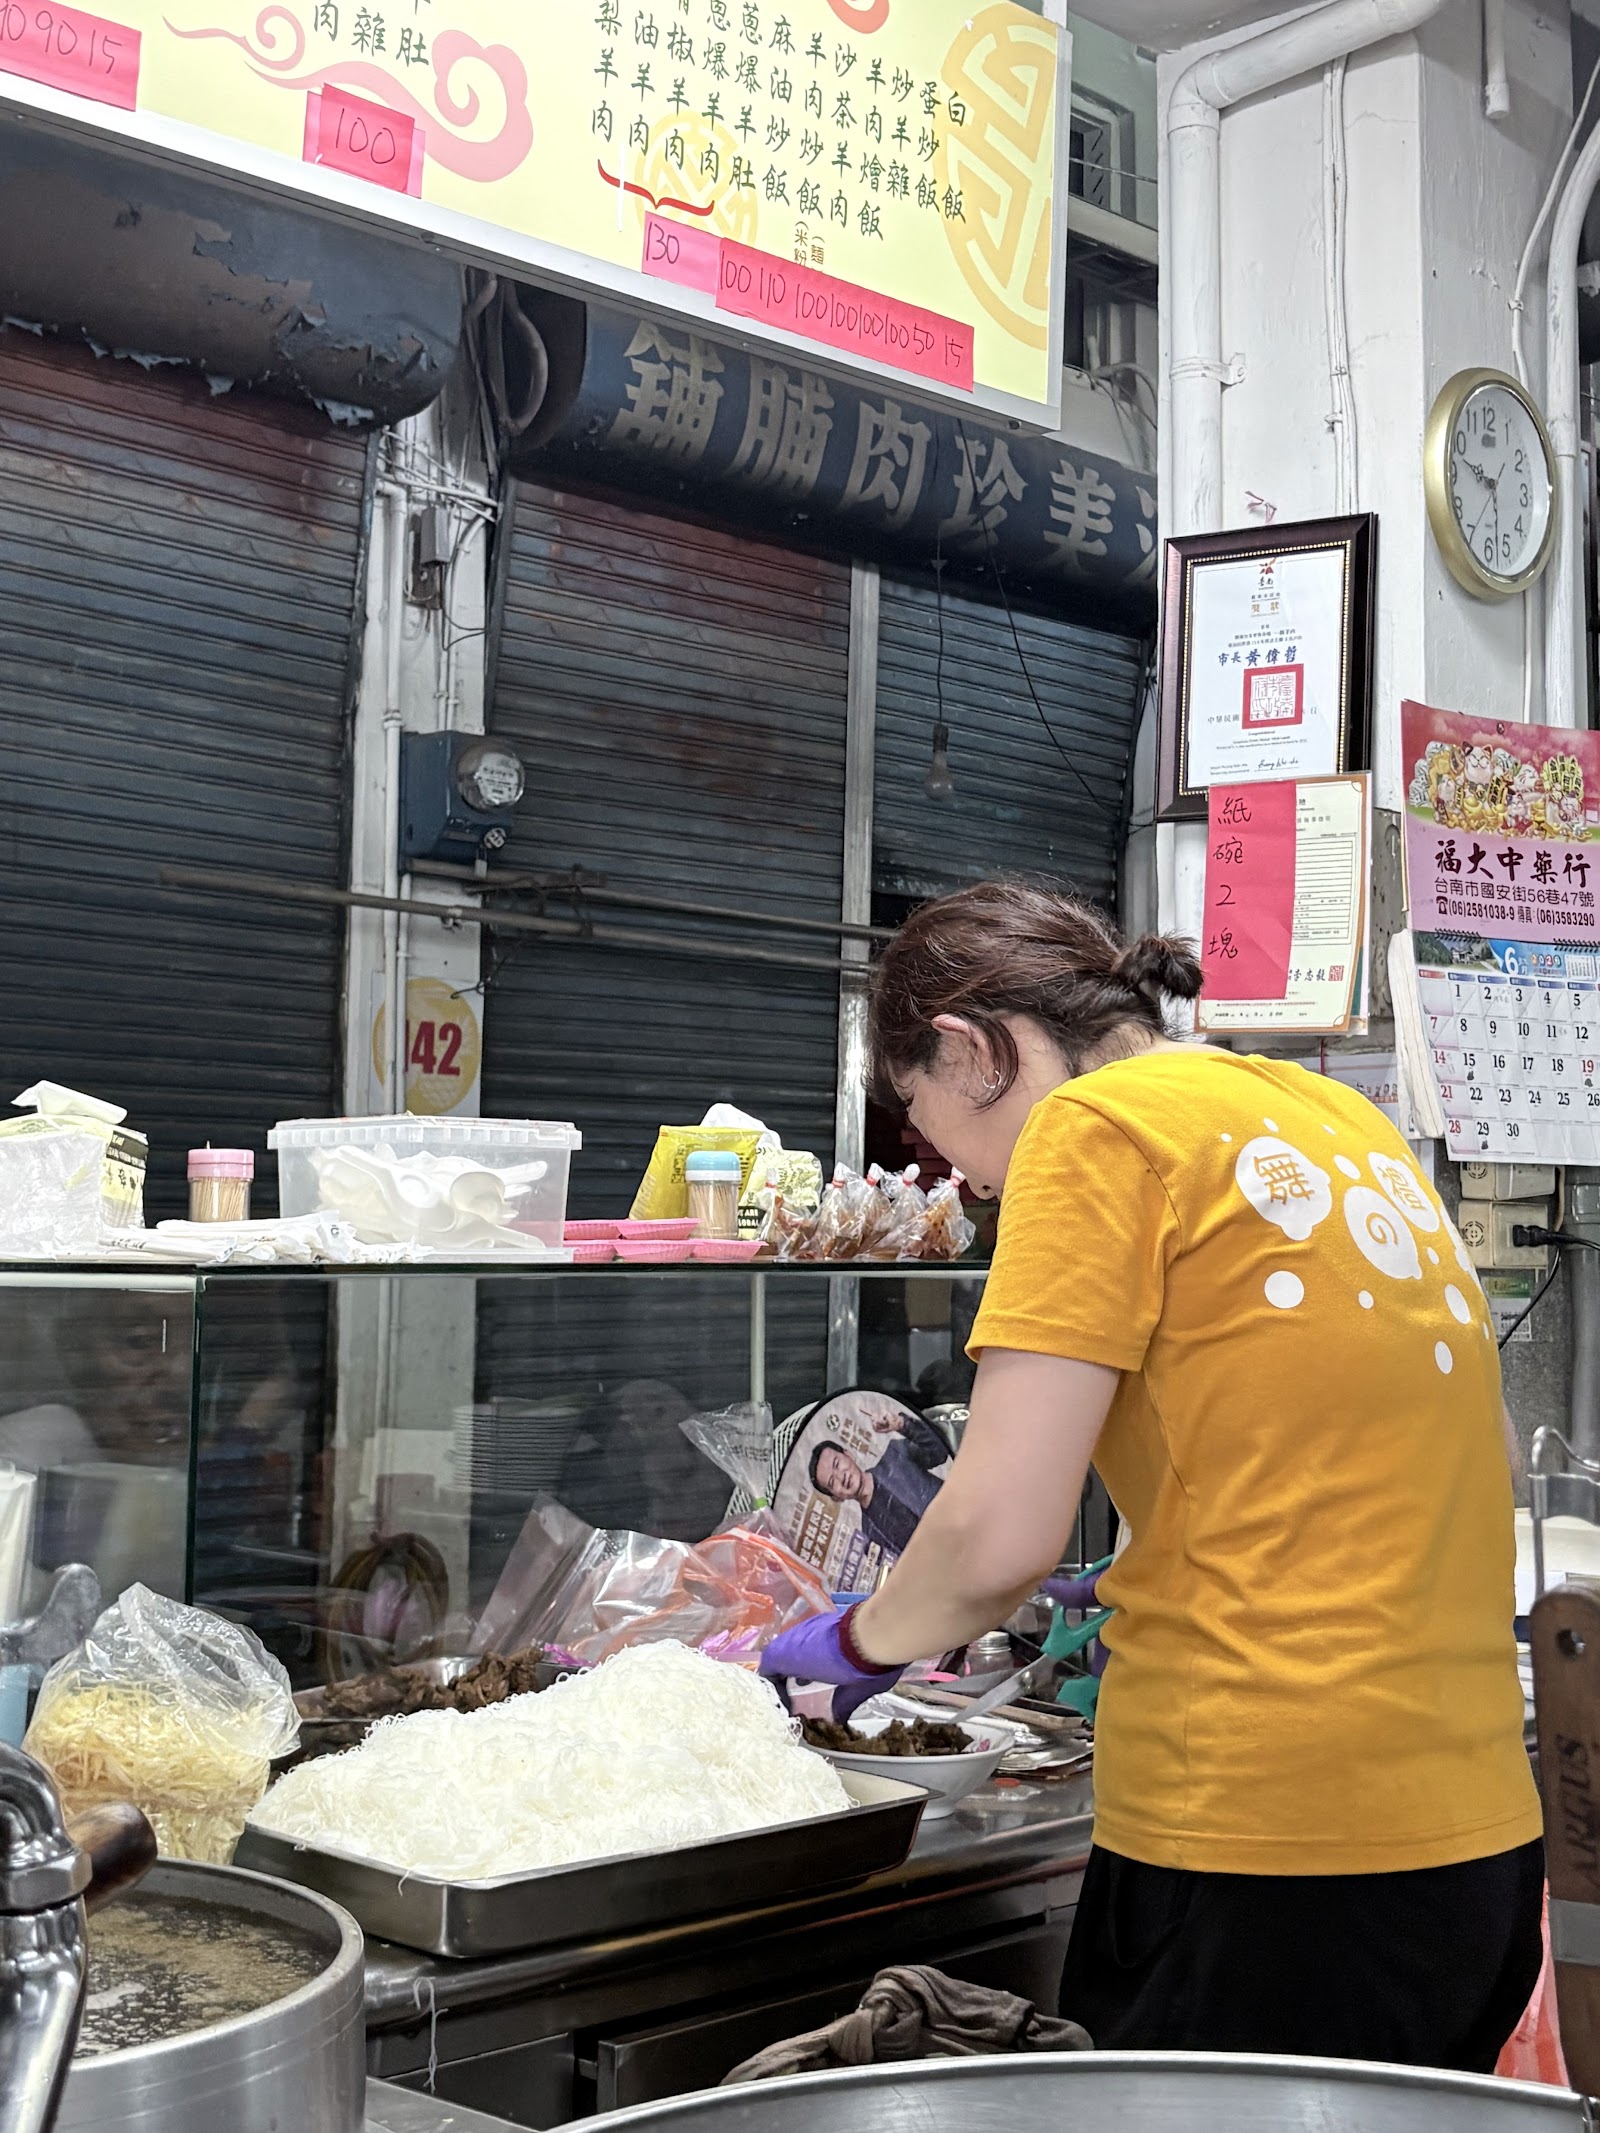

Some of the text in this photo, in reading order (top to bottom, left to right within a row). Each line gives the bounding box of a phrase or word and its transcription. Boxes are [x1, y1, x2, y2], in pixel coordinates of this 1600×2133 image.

[35, 10, 77, 56] 90
[89, 29, 123, 73] 15
[762, 14, 795, 206] 麻油炒飯
[335, 107, 397, 165] 100
[796, 32, 827, 219] 羊肉炒飯
[830, 43, 858, 228] 沙茶羊肉
[886, 66, 914, 200] 炒羊雜
[857, 57, 886, 241] 羊肉燴飯
[915, 81, 942, 213] 蛋炒飯
[941, 91, 966, 224] 白飯
[646, 222, 680, 264] 130
[719, 250, 964, 368] 100 110 100 100 100 100 50 15
[1465, 408, 1477, 434] 11
[1481, 406, 1496, 433] 12
[1504, 423, 1509, 445] 1
[1514, 449, 1524, 474] 2
[1519, 483, 1529, 508] 3
[1466, 523, 1476, 544] 7
[1514, 515, 1523, 537] 4
[1484, 537, 1494, 562] 6
[1501, 533, 1511, 558] 5
[1435, 839, 1591, 888] 福大中藥行
[1434, 877, 1595, 908] 台南市國安街56巷47號
[1504, 946, 1519, 975] 6
[1455, 984, 1581, 1006] 1 2 3 4 5
[1430, 1017, 1589, 1040] 7 8 9 10 11 12
[1434, 1051, 1594, 1073] 14 15 16 17 18 19
[1440, 1085, 1453, 1098] 21
[1469, 1087, 1483, 1100] 22
[1499, 1089, 1512, 1103] 23
[1528, 1091, 1542, 1104] 24
[1557, 1092, 1570, 1106] 25
[1448, 1120, 1520, 1137] 28 29 30
